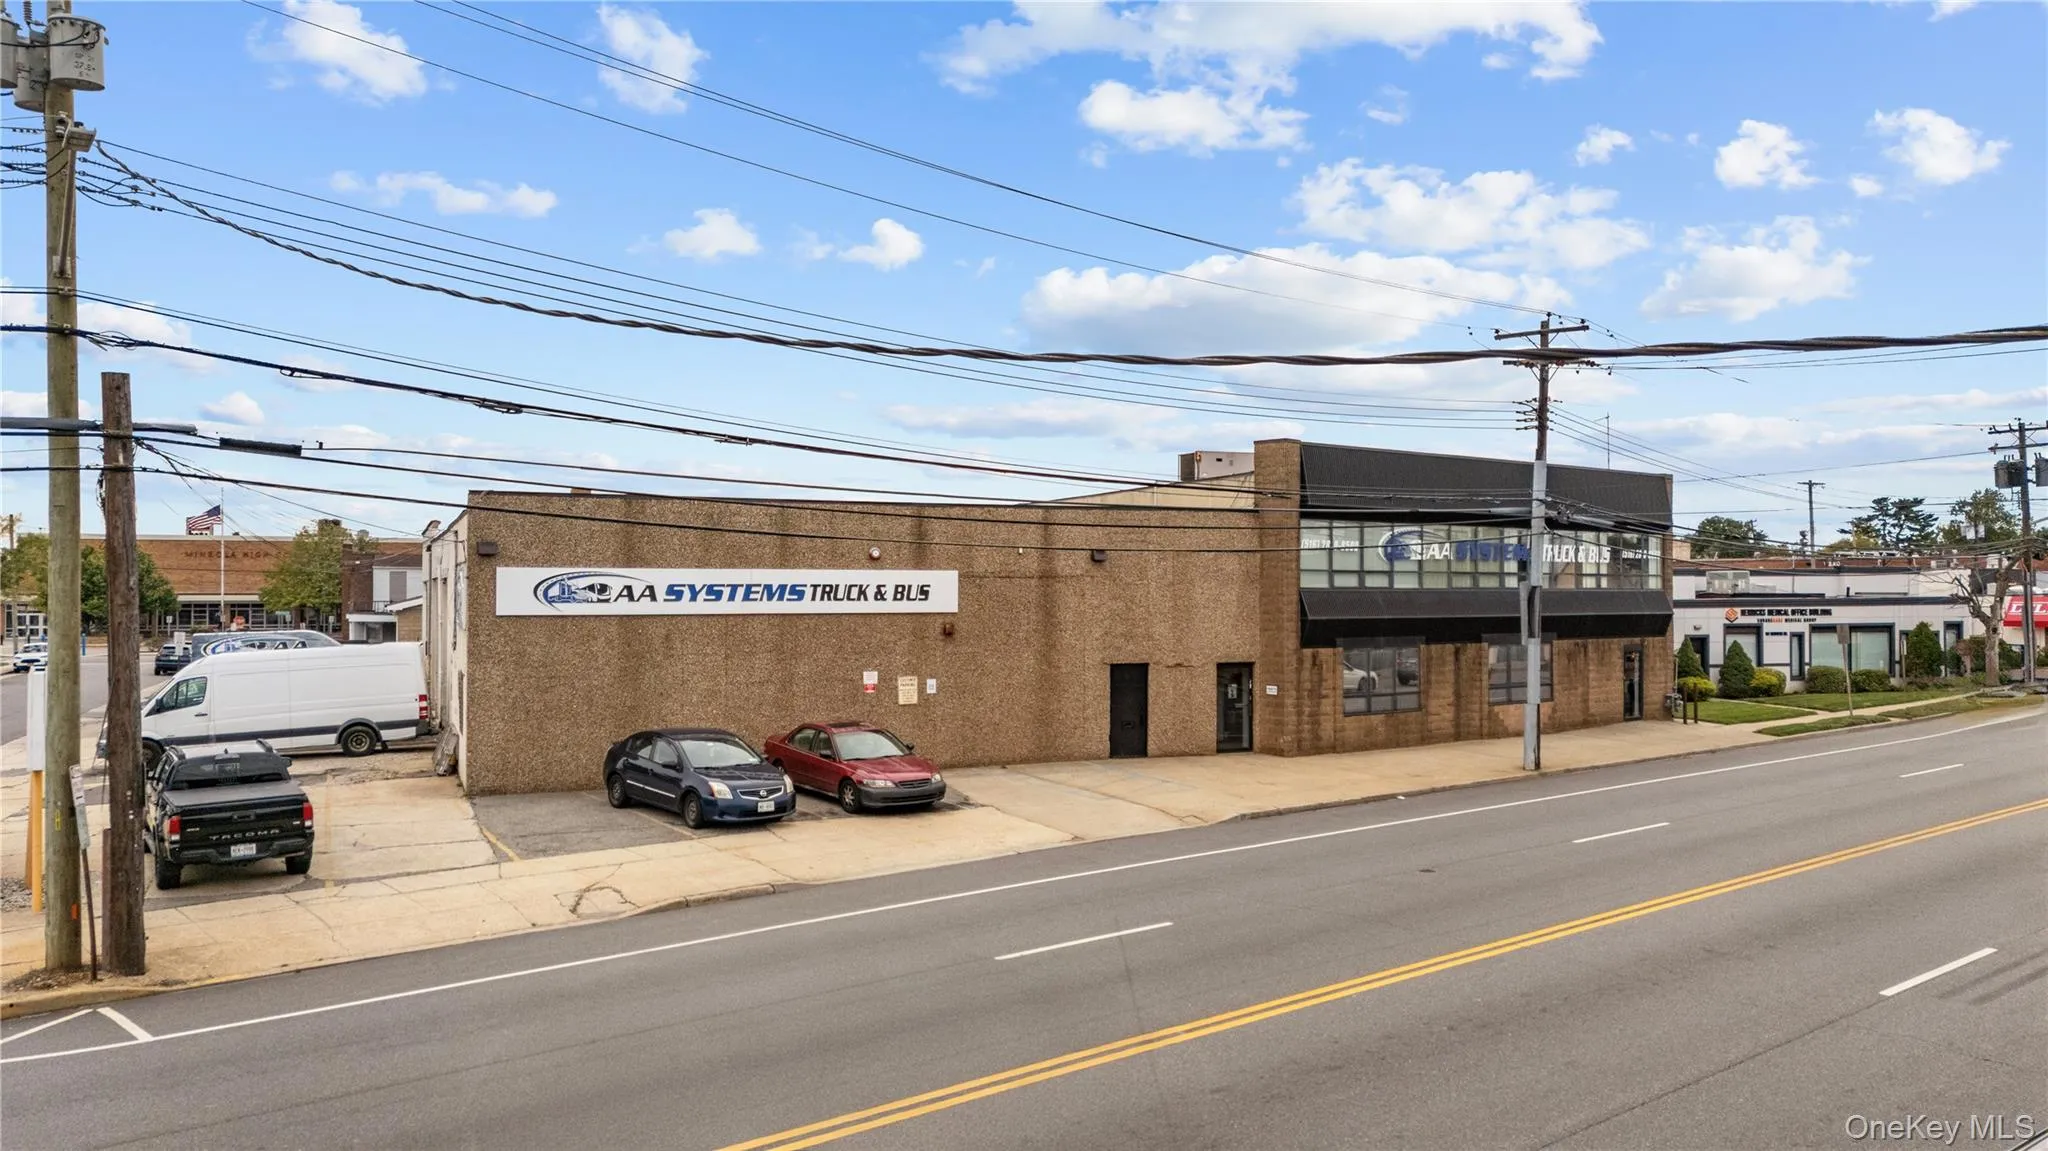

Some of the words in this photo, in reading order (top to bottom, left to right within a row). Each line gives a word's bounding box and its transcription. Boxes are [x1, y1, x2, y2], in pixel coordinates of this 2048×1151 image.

[1426, 543, 1453, 560] AA
[1455, 542, 1532, 561] SYSTEM
[1542, 544, 1577, 562] TRUCK
[1577, 545, 1586, 563] &
[1588, 546, 1611, 563] BUS
[613, 584, 657, 602] AA
[663, 583, 807, 602] SYSTEMS
[809, 584, 869, 601] TRUCK
[873, 584, 887, 601] &
[892, 584, 931, 601] BUS
[209, 828, 280, 841] TACOMA
